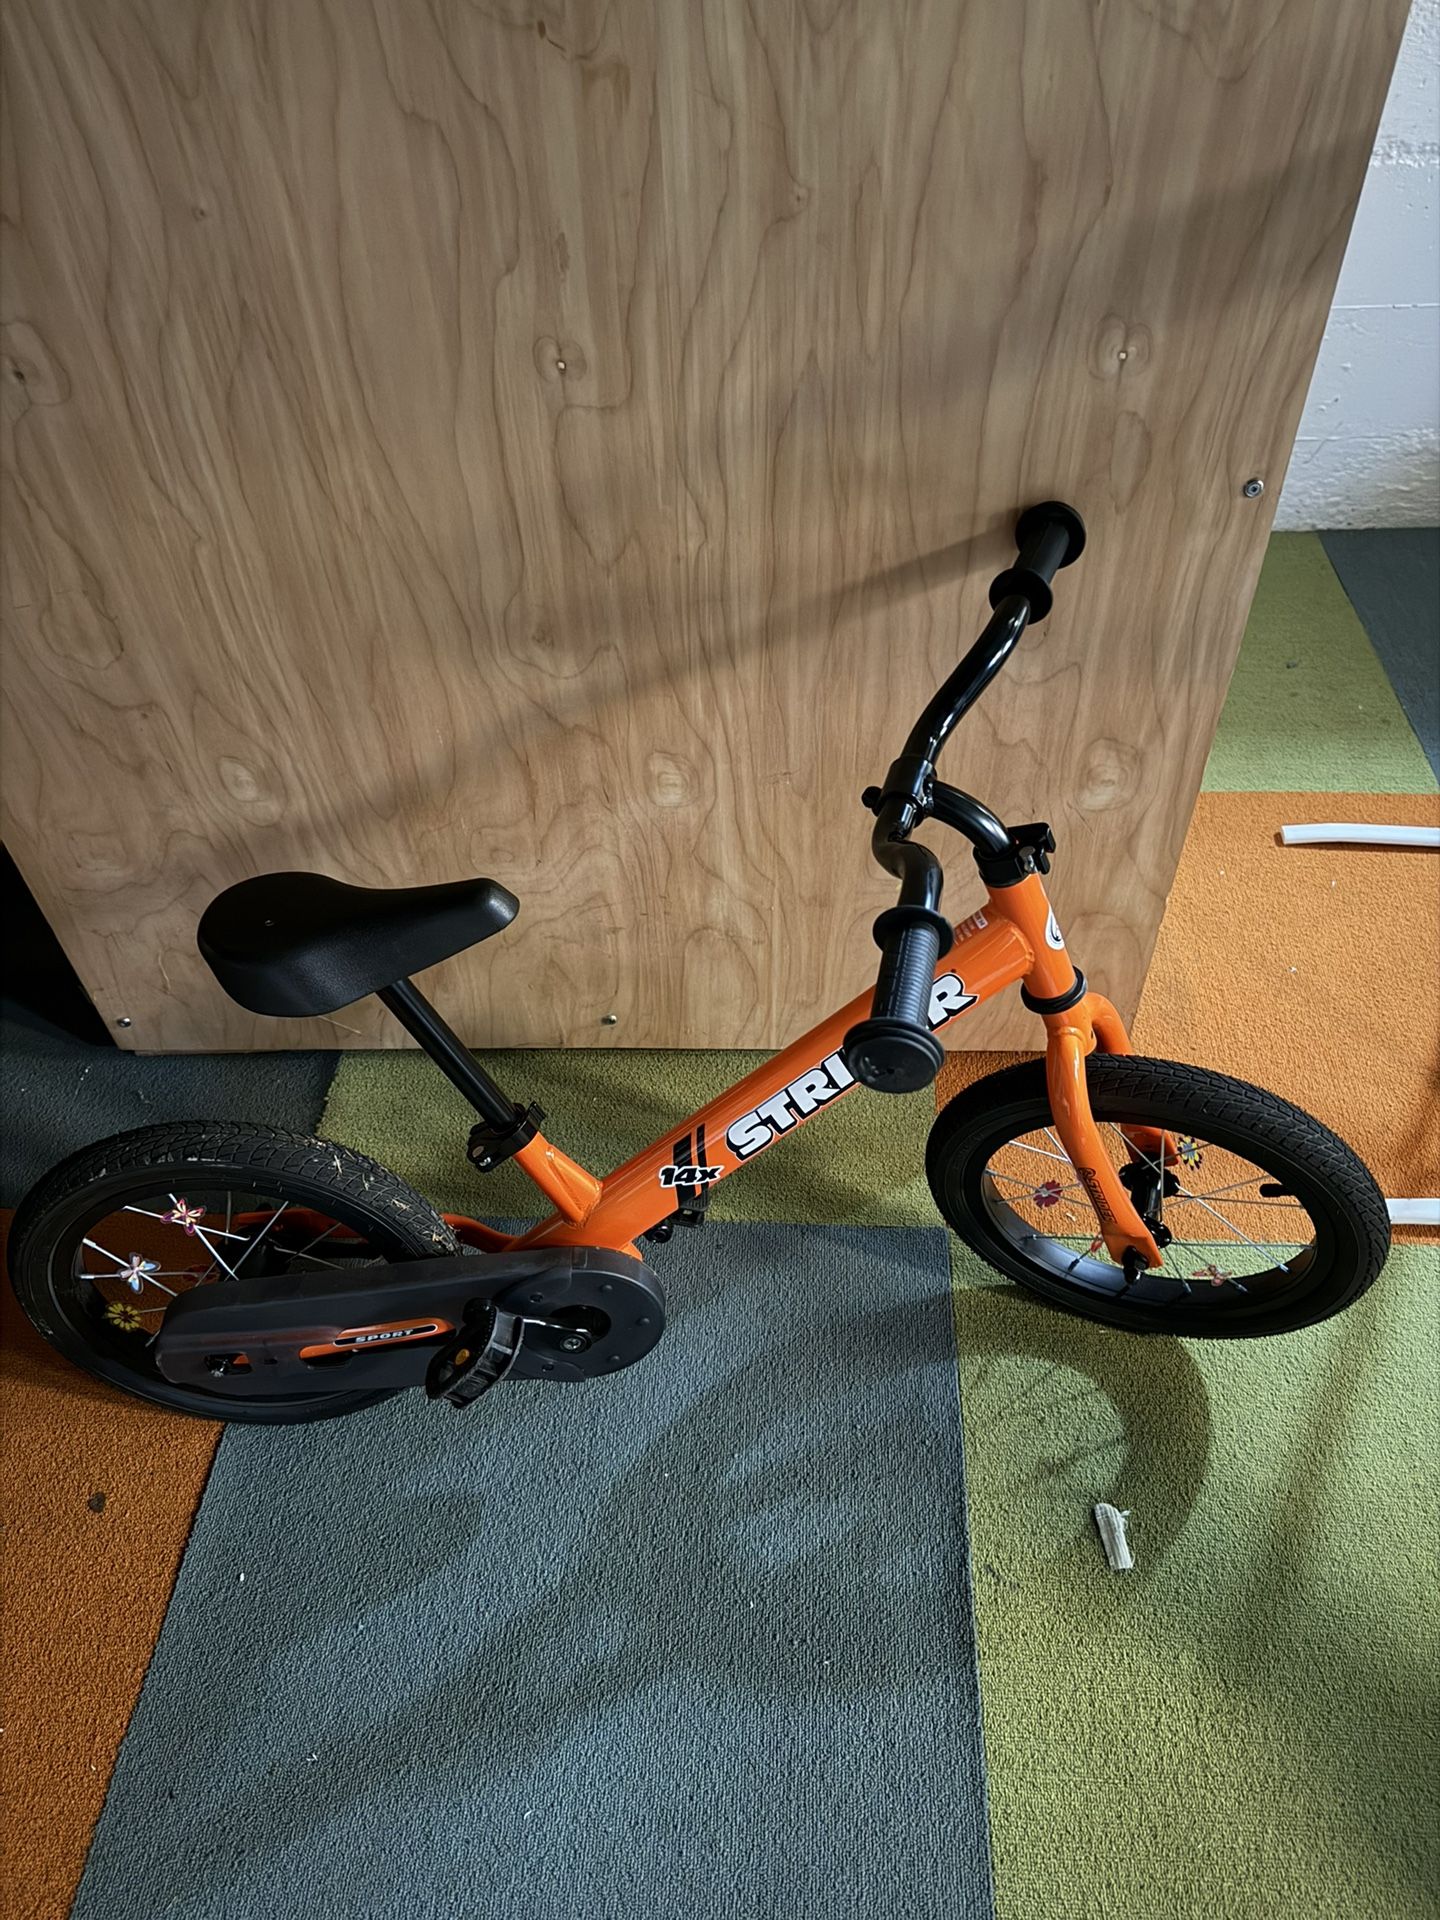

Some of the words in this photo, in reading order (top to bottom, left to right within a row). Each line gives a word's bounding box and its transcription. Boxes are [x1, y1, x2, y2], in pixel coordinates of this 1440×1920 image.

[727, 975, 978, 1161] STRIR
[660, 1166, 723, 1187] 14x
[355, 1329, 414, 1343] SPORT
